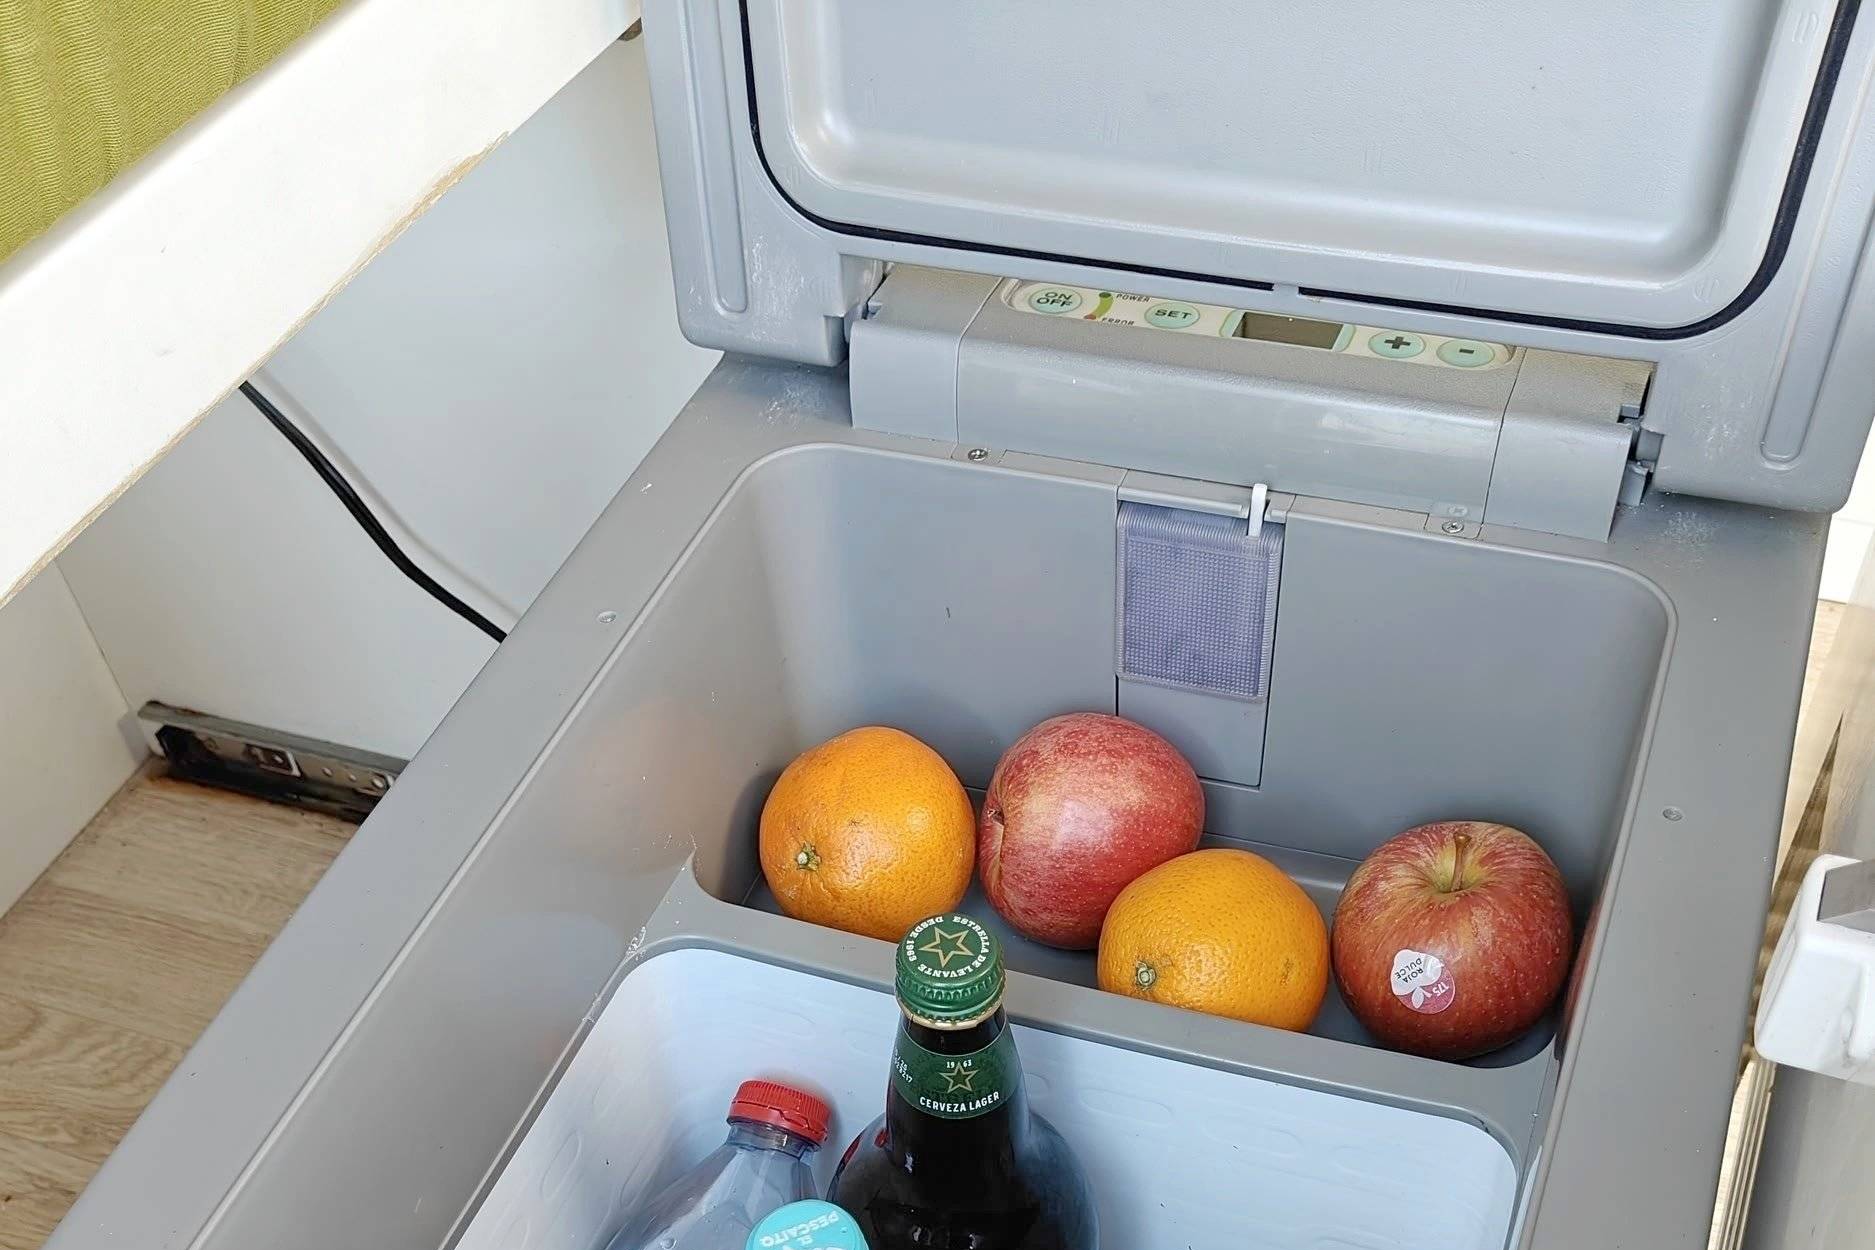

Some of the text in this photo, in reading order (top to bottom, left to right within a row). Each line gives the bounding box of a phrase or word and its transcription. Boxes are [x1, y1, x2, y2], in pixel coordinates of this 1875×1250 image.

[1037, 297, 1073, 308] OFF
[1045, 291, 1073, 300] ON
[1116, 293, 1150, 302] POWER
[1155, 309, 1192, 320] SET
[909, 915, 944, 938] DESDE
[917, 915, 990, 978] ESTRELLA DE LEVANTE
[1395, 958, 1422, 979] DULCE
[1402, 968, 1424, 983] ROJA
[919, 1091, 1000, 1113] CERVEZA LAGER
